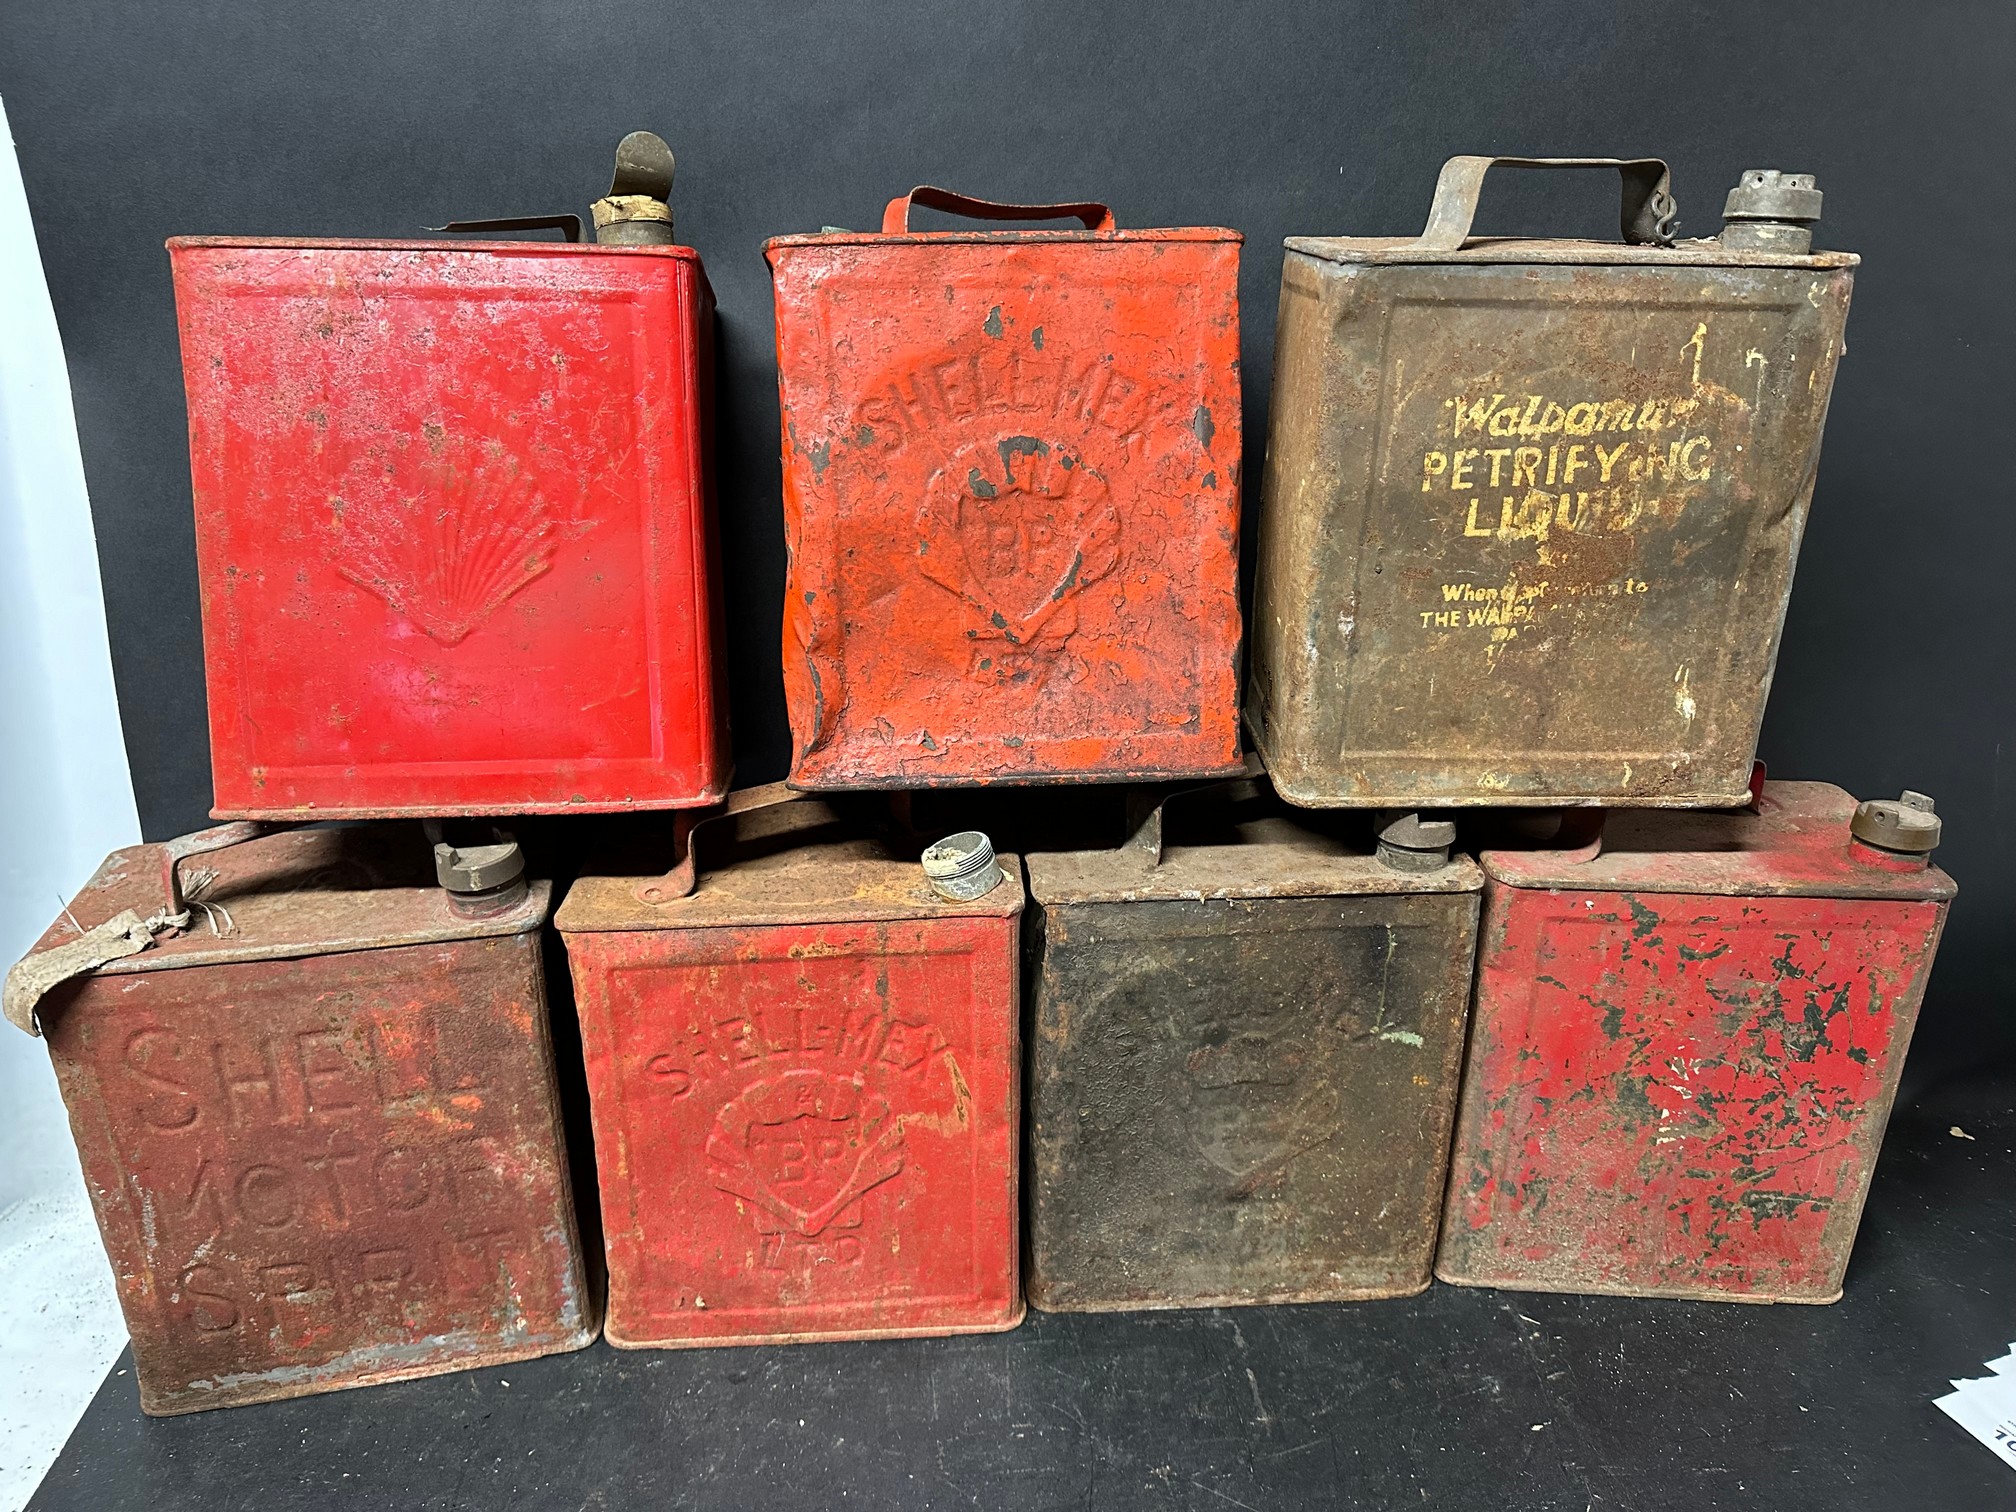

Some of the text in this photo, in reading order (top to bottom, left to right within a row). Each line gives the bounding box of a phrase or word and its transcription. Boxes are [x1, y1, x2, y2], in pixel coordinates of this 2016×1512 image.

[1441, 583, 1499, 602] When
[1419, 610, 1462, 629] THE
[122, 1016, 492, 1134] SHELL
